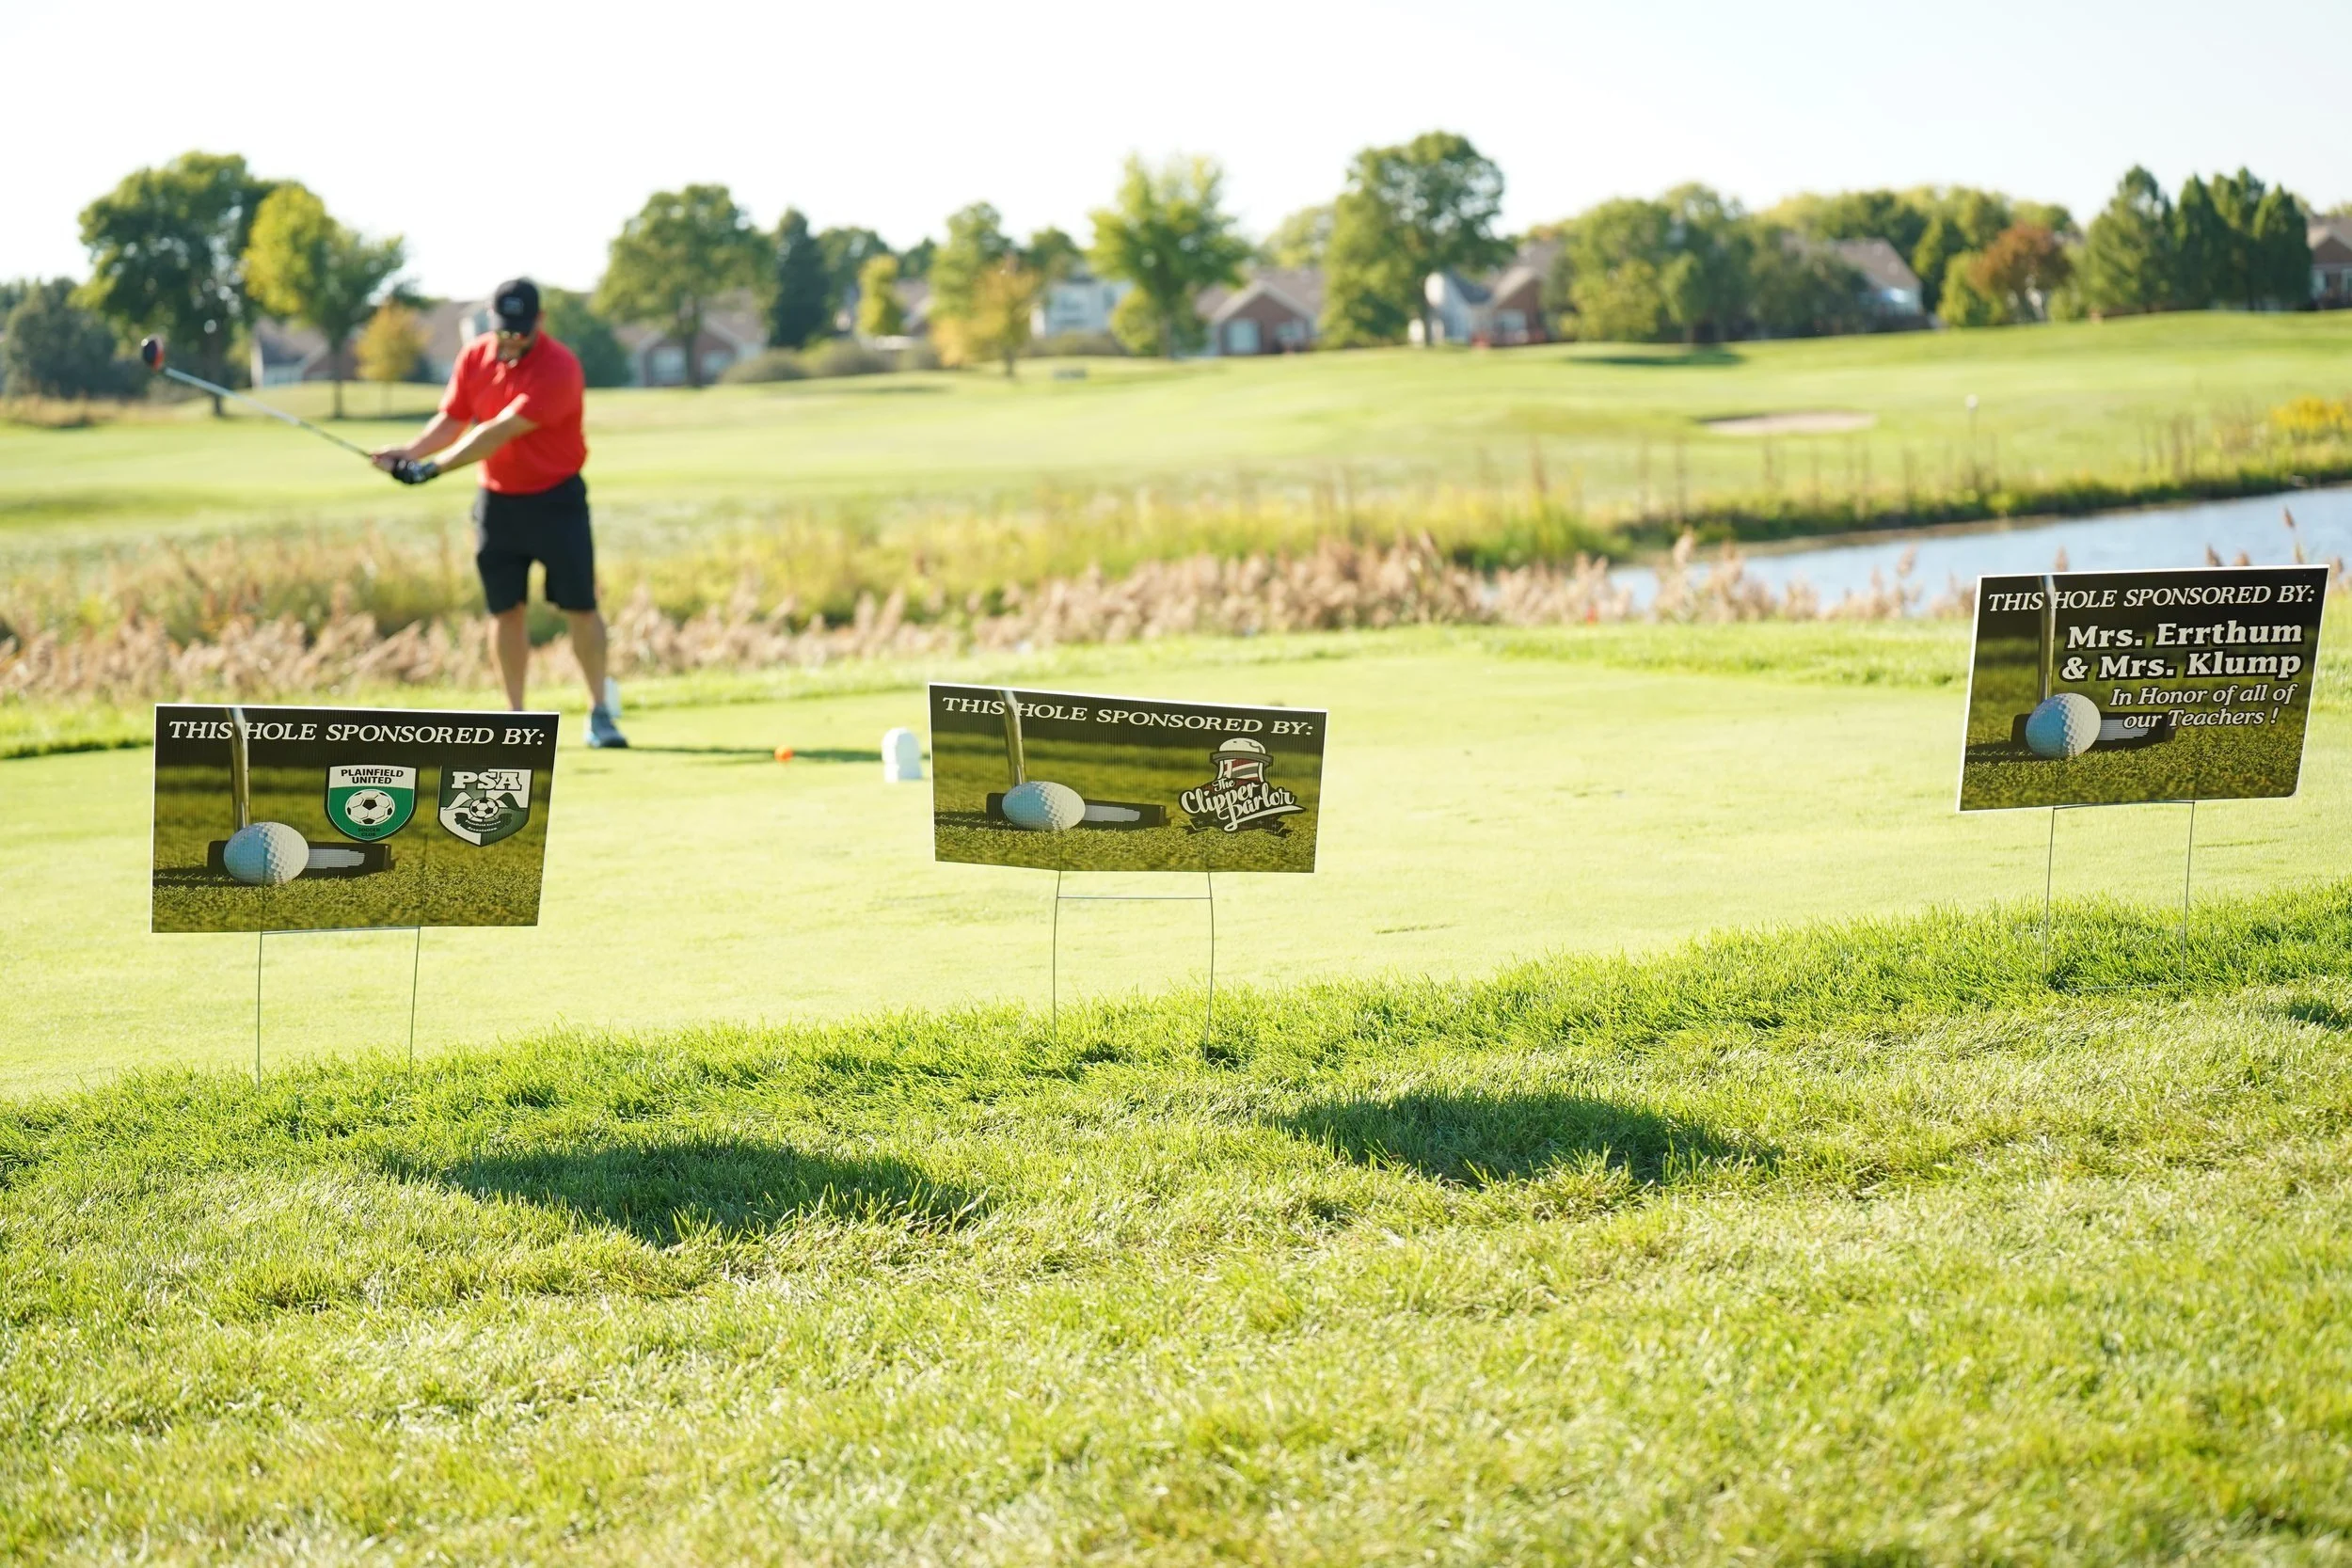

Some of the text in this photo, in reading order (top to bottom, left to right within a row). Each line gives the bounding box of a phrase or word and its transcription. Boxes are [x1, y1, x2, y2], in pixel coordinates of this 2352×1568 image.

[1989, 584, 2315, 611] THIS HOLE SPONSORED BY:
[2067, 620, 2302, 649] Mrs. Errthum
[2061, 651, 2301, 679] & Mrs. Klump
[2109, 683, 2299, 707] In Honor of all of
[943, 697, 1313, 736] THIS HOLE SPONSORED BY:
[2122, 706, 2279, 729] our Teachers !
[169, 721, 546, 746] THIS HOLE SPONSORED BY:
[341, 768, 405, 778] PLAINFIELD
[351, 776, 392, 784] UNITED
[452, 771, 522, 791] PSA
[1212, 778, 1235, 792] The
[1181, 783, 1260, 820] Clipper
